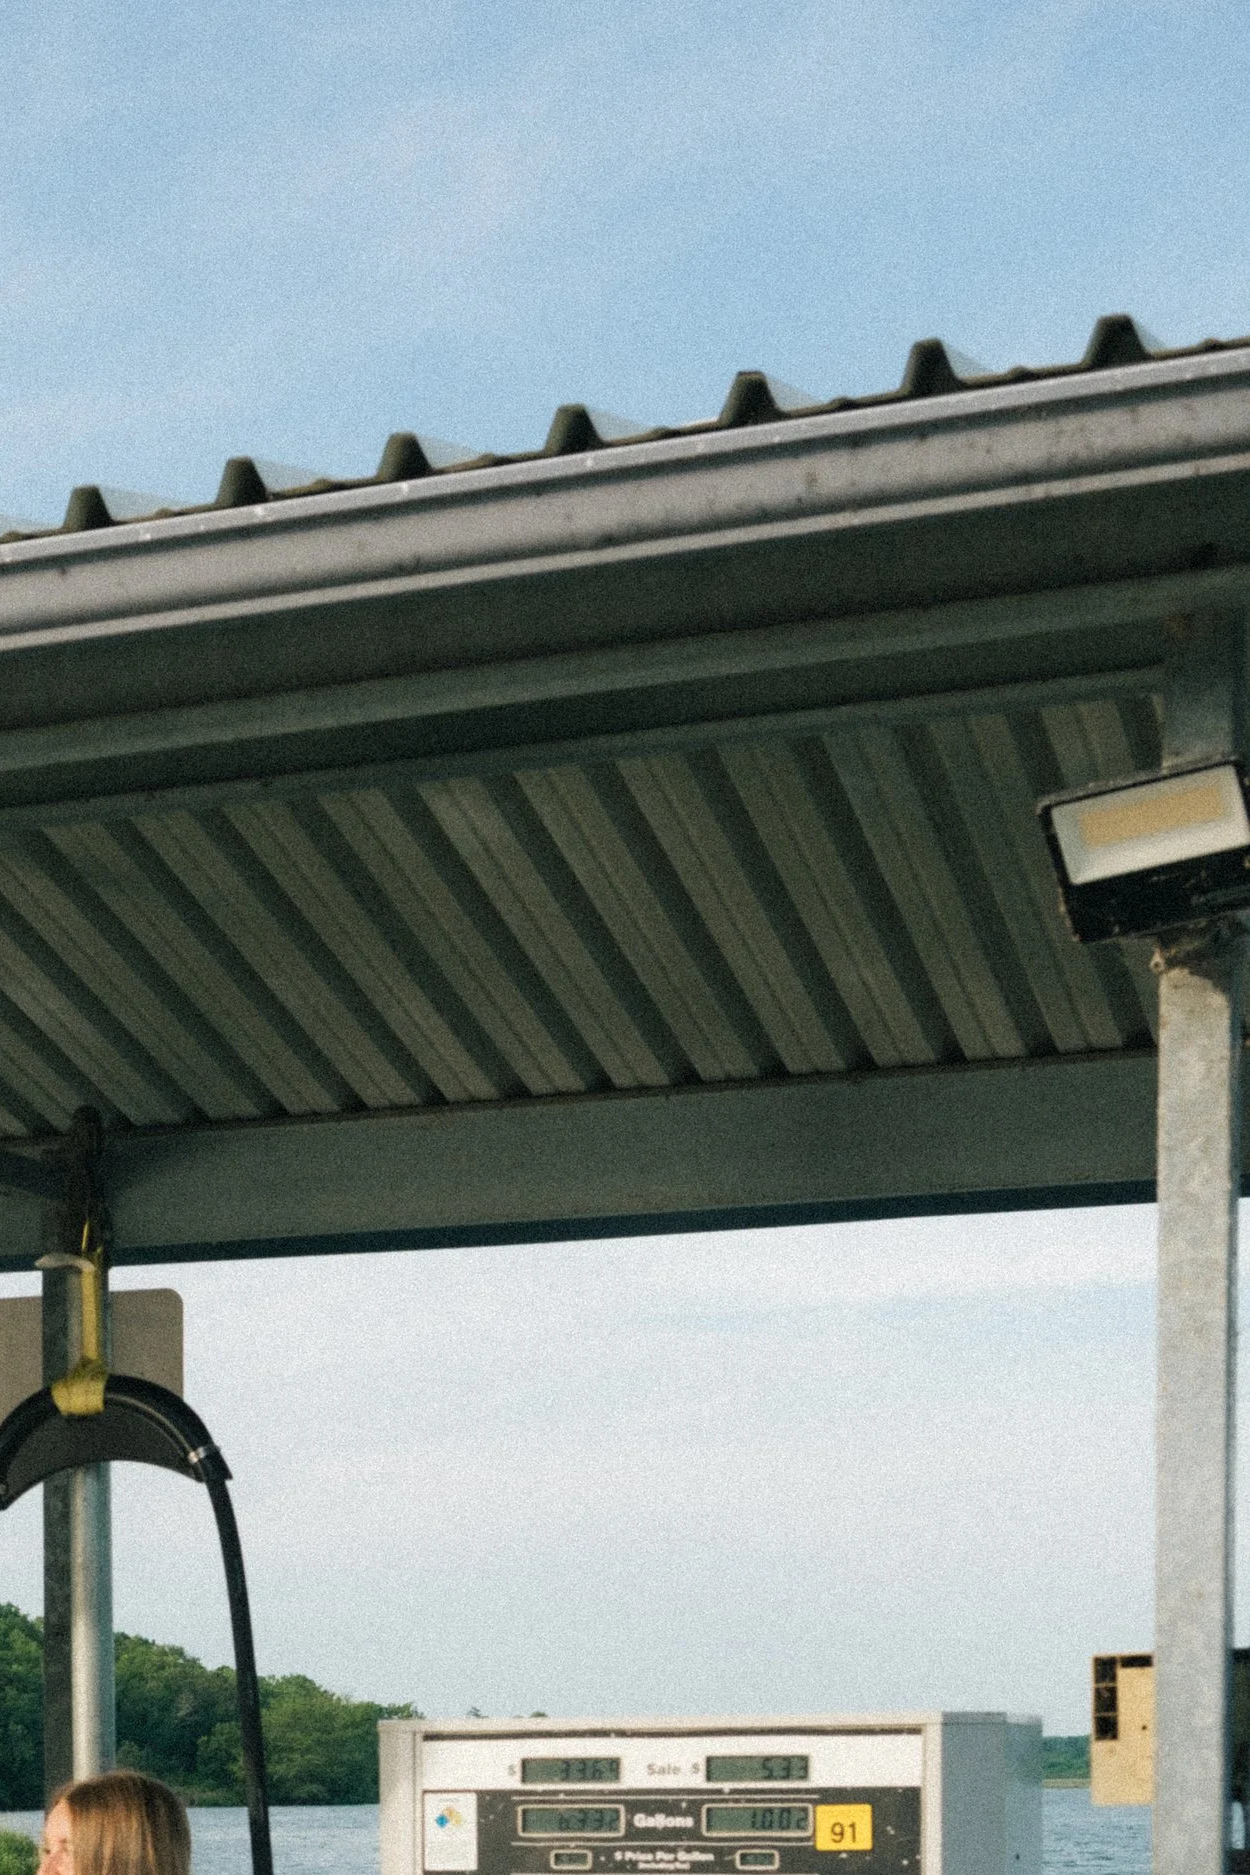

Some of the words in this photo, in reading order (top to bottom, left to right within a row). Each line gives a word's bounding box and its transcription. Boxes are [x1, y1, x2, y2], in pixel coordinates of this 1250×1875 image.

[647, 1764, 682, 1776] Sale
[633, 1813, 694, 1830] Gallons
[830, 1821, 859, 1844] 91
